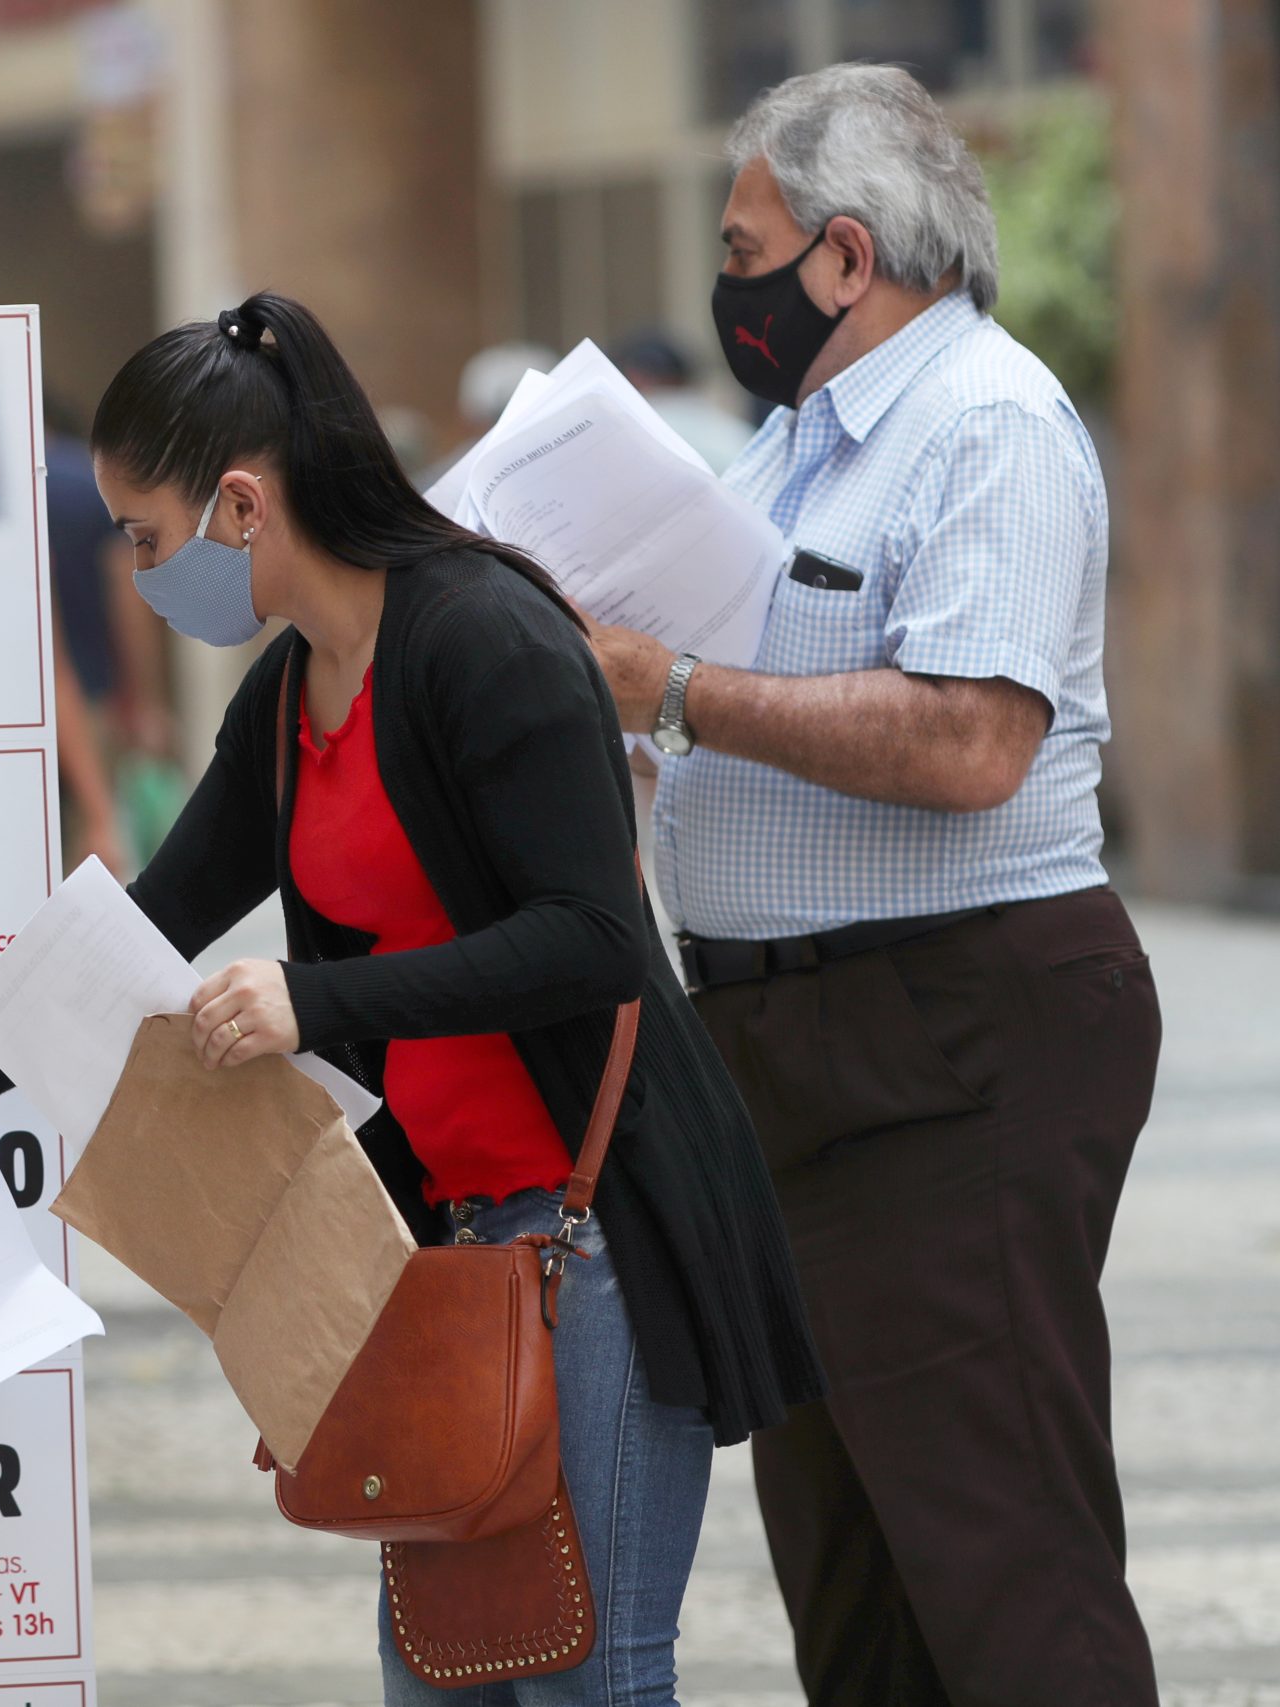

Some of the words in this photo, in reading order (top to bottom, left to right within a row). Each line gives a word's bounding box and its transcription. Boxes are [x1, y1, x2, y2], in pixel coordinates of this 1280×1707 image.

[553, 419, 593, 446] ALMEIDA
[10, 1582, 40, 1604] VT
[13, 1611, 54, 1636] 13h
